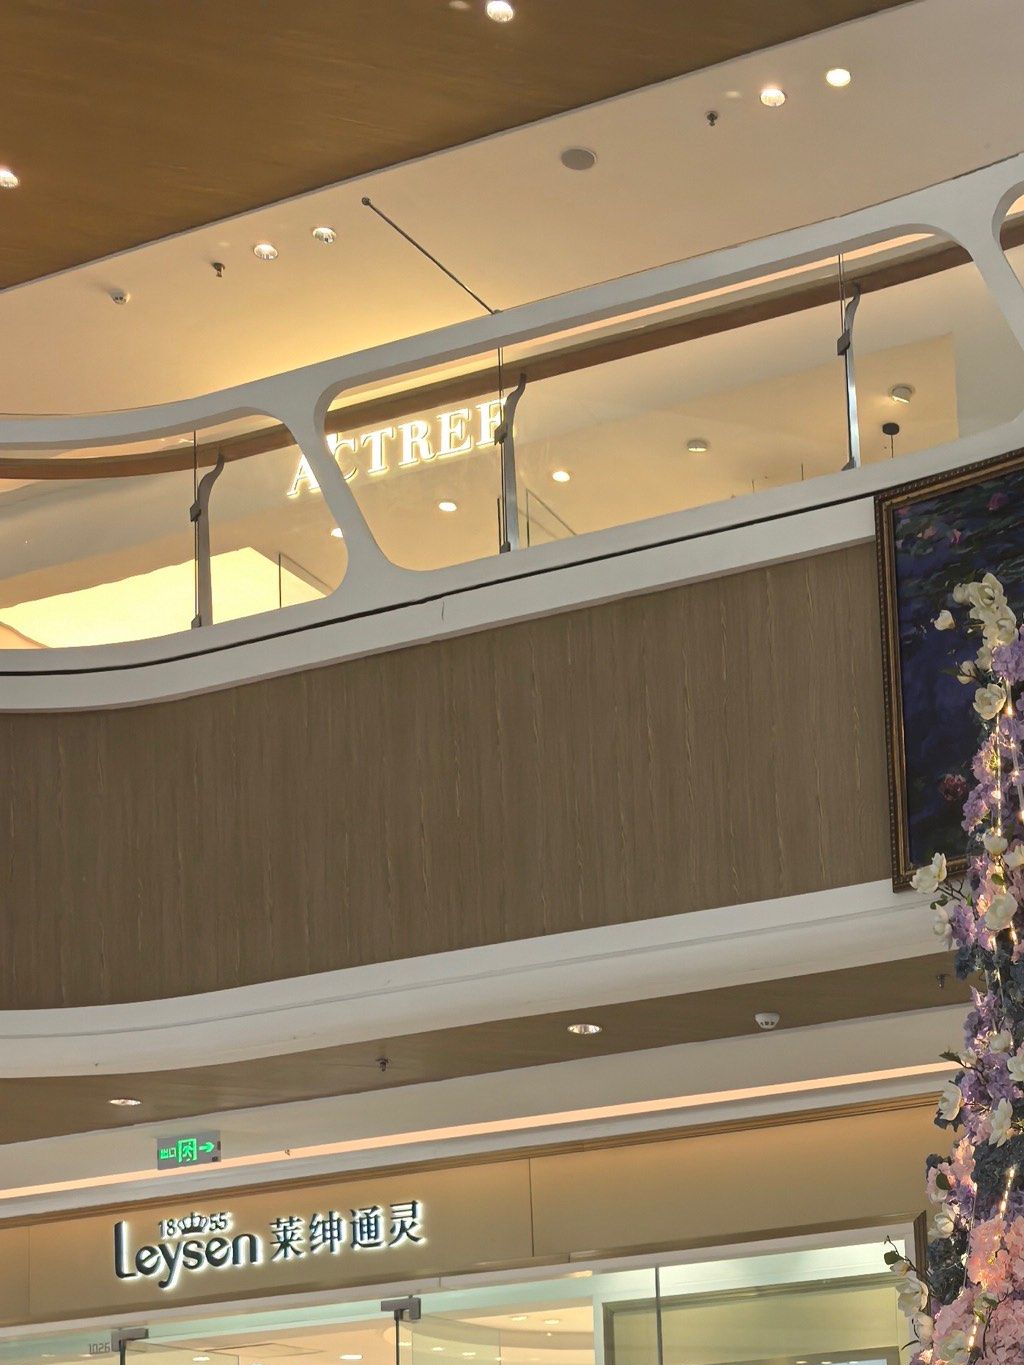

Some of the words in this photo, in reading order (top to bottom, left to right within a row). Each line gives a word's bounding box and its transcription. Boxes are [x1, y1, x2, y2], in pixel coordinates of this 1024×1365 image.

[160, 1147, 177, 1159] 出口
[113, 1219, 261, 1289] Leysen
[269, 1200, 425, 1261] 莱绅通灵
